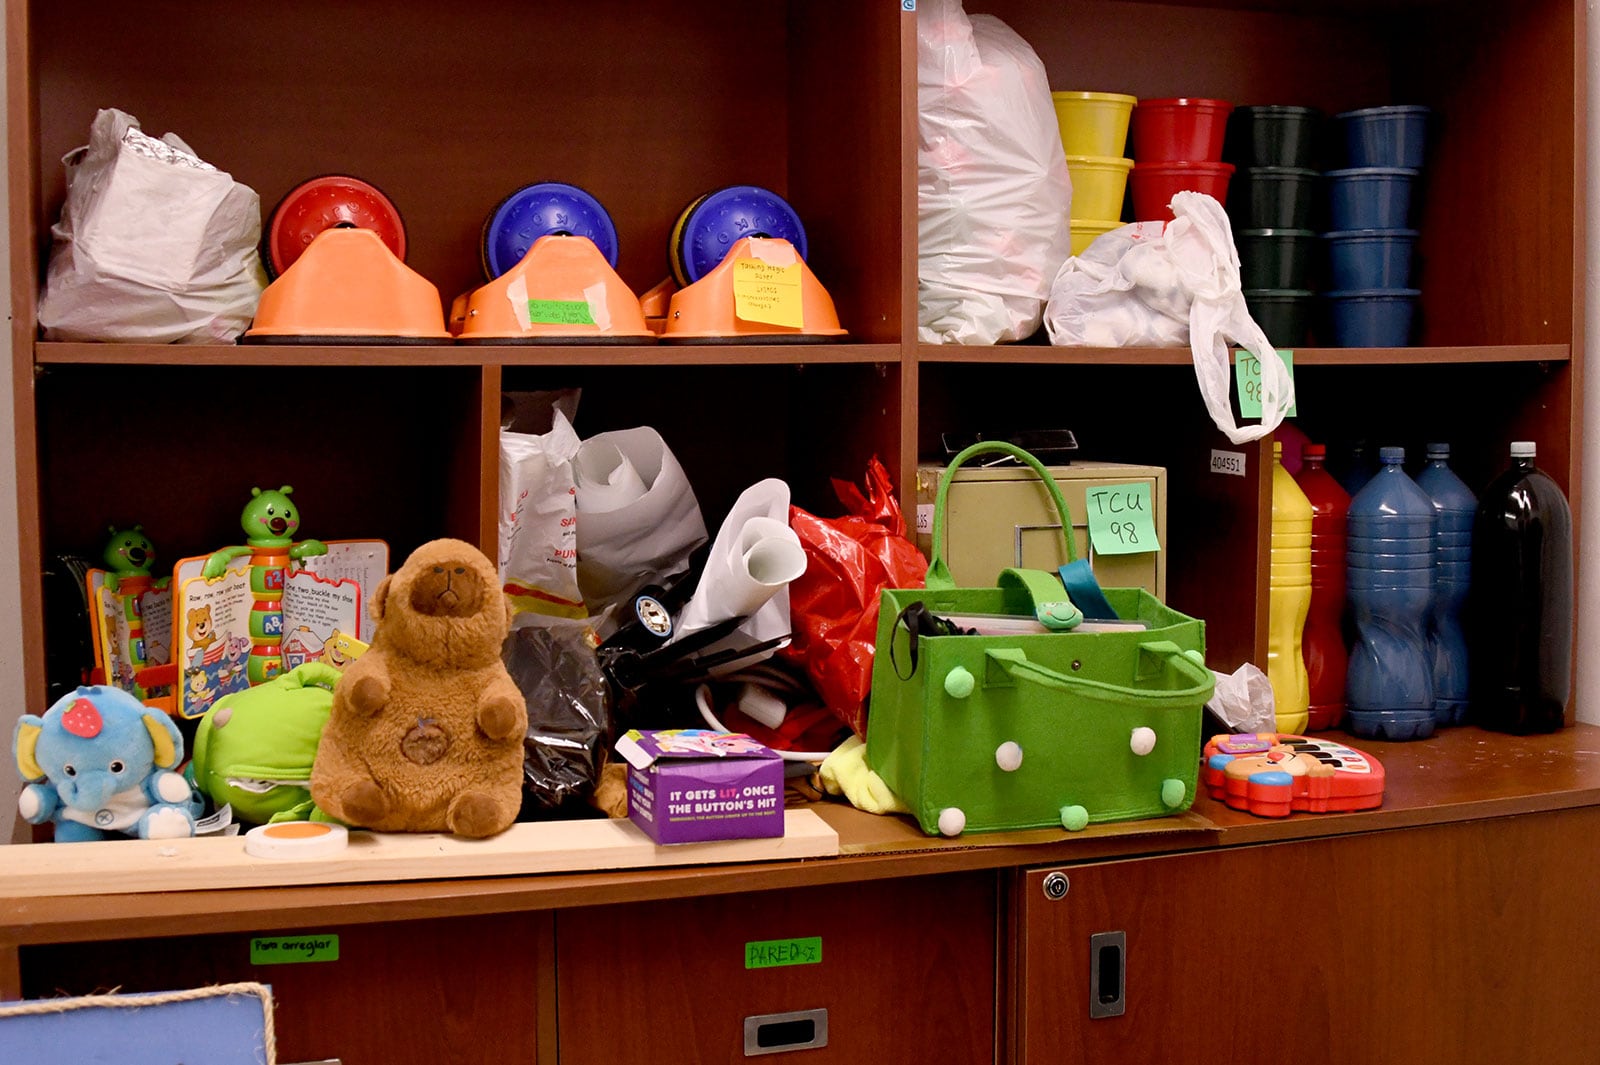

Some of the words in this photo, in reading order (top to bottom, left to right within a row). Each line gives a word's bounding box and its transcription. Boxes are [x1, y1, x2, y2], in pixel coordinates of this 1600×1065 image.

[1212, 456, 1240, 471] 404551
[1091, 491, 1143, 515] TCU
[1110, 521, 1139, 544] 98
[670, 791, 682, 801] IT
[685, 789, 716, 801] GETS
[719, 788, 740, 799] LIT,
[743, 785, 775, 797] ONCE
[668, 804, 691, 815] THE
[695, 800, 754, 813] BUTTON'S
[757, 798, 777, 808] HIT
[282, 940, 331, 957] arreglar
